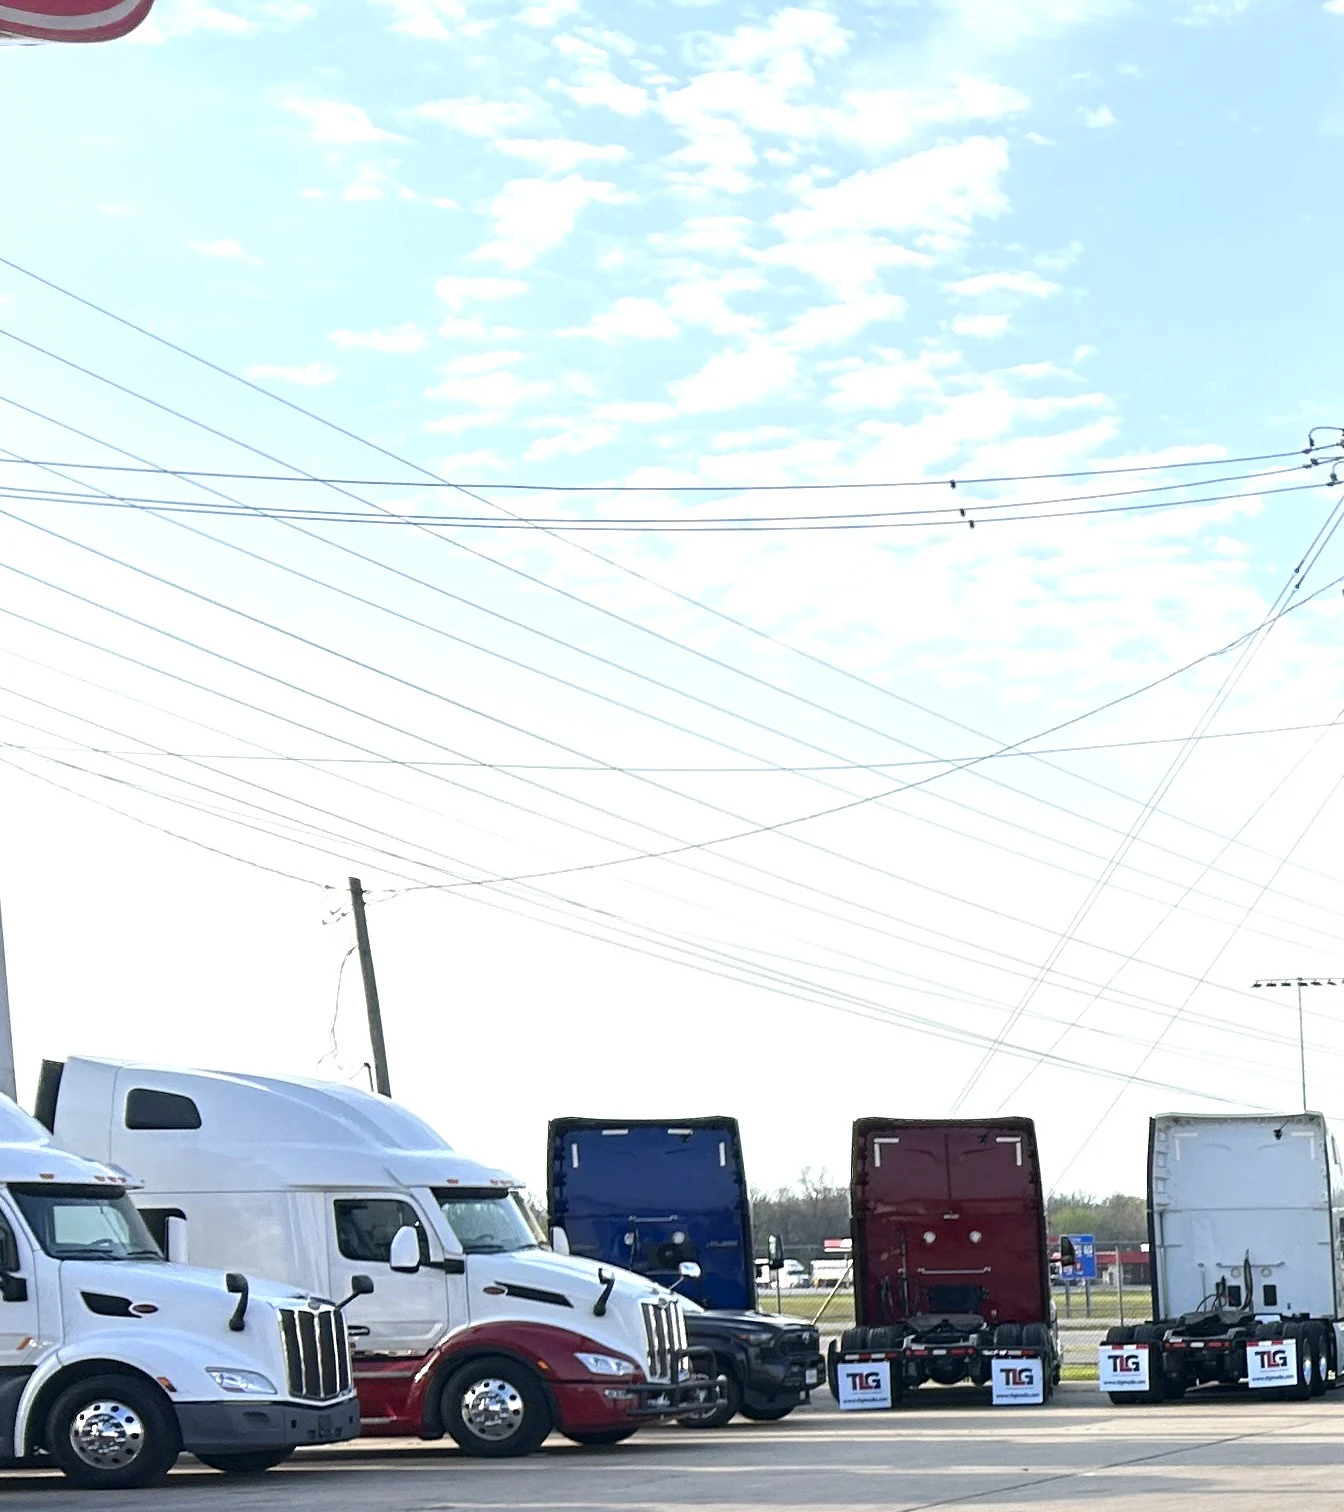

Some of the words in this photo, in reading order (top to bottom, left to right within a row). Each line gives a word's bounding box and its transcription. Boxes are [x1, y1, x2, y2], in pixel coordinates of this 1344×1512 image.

[1107, 1354, 1140, 1373] TLG
[1254, 1350, 1288, 1369] TLG
[845, 1372, 882, 1391] TLG
[999, 1368, 1034, 1386] TLG
